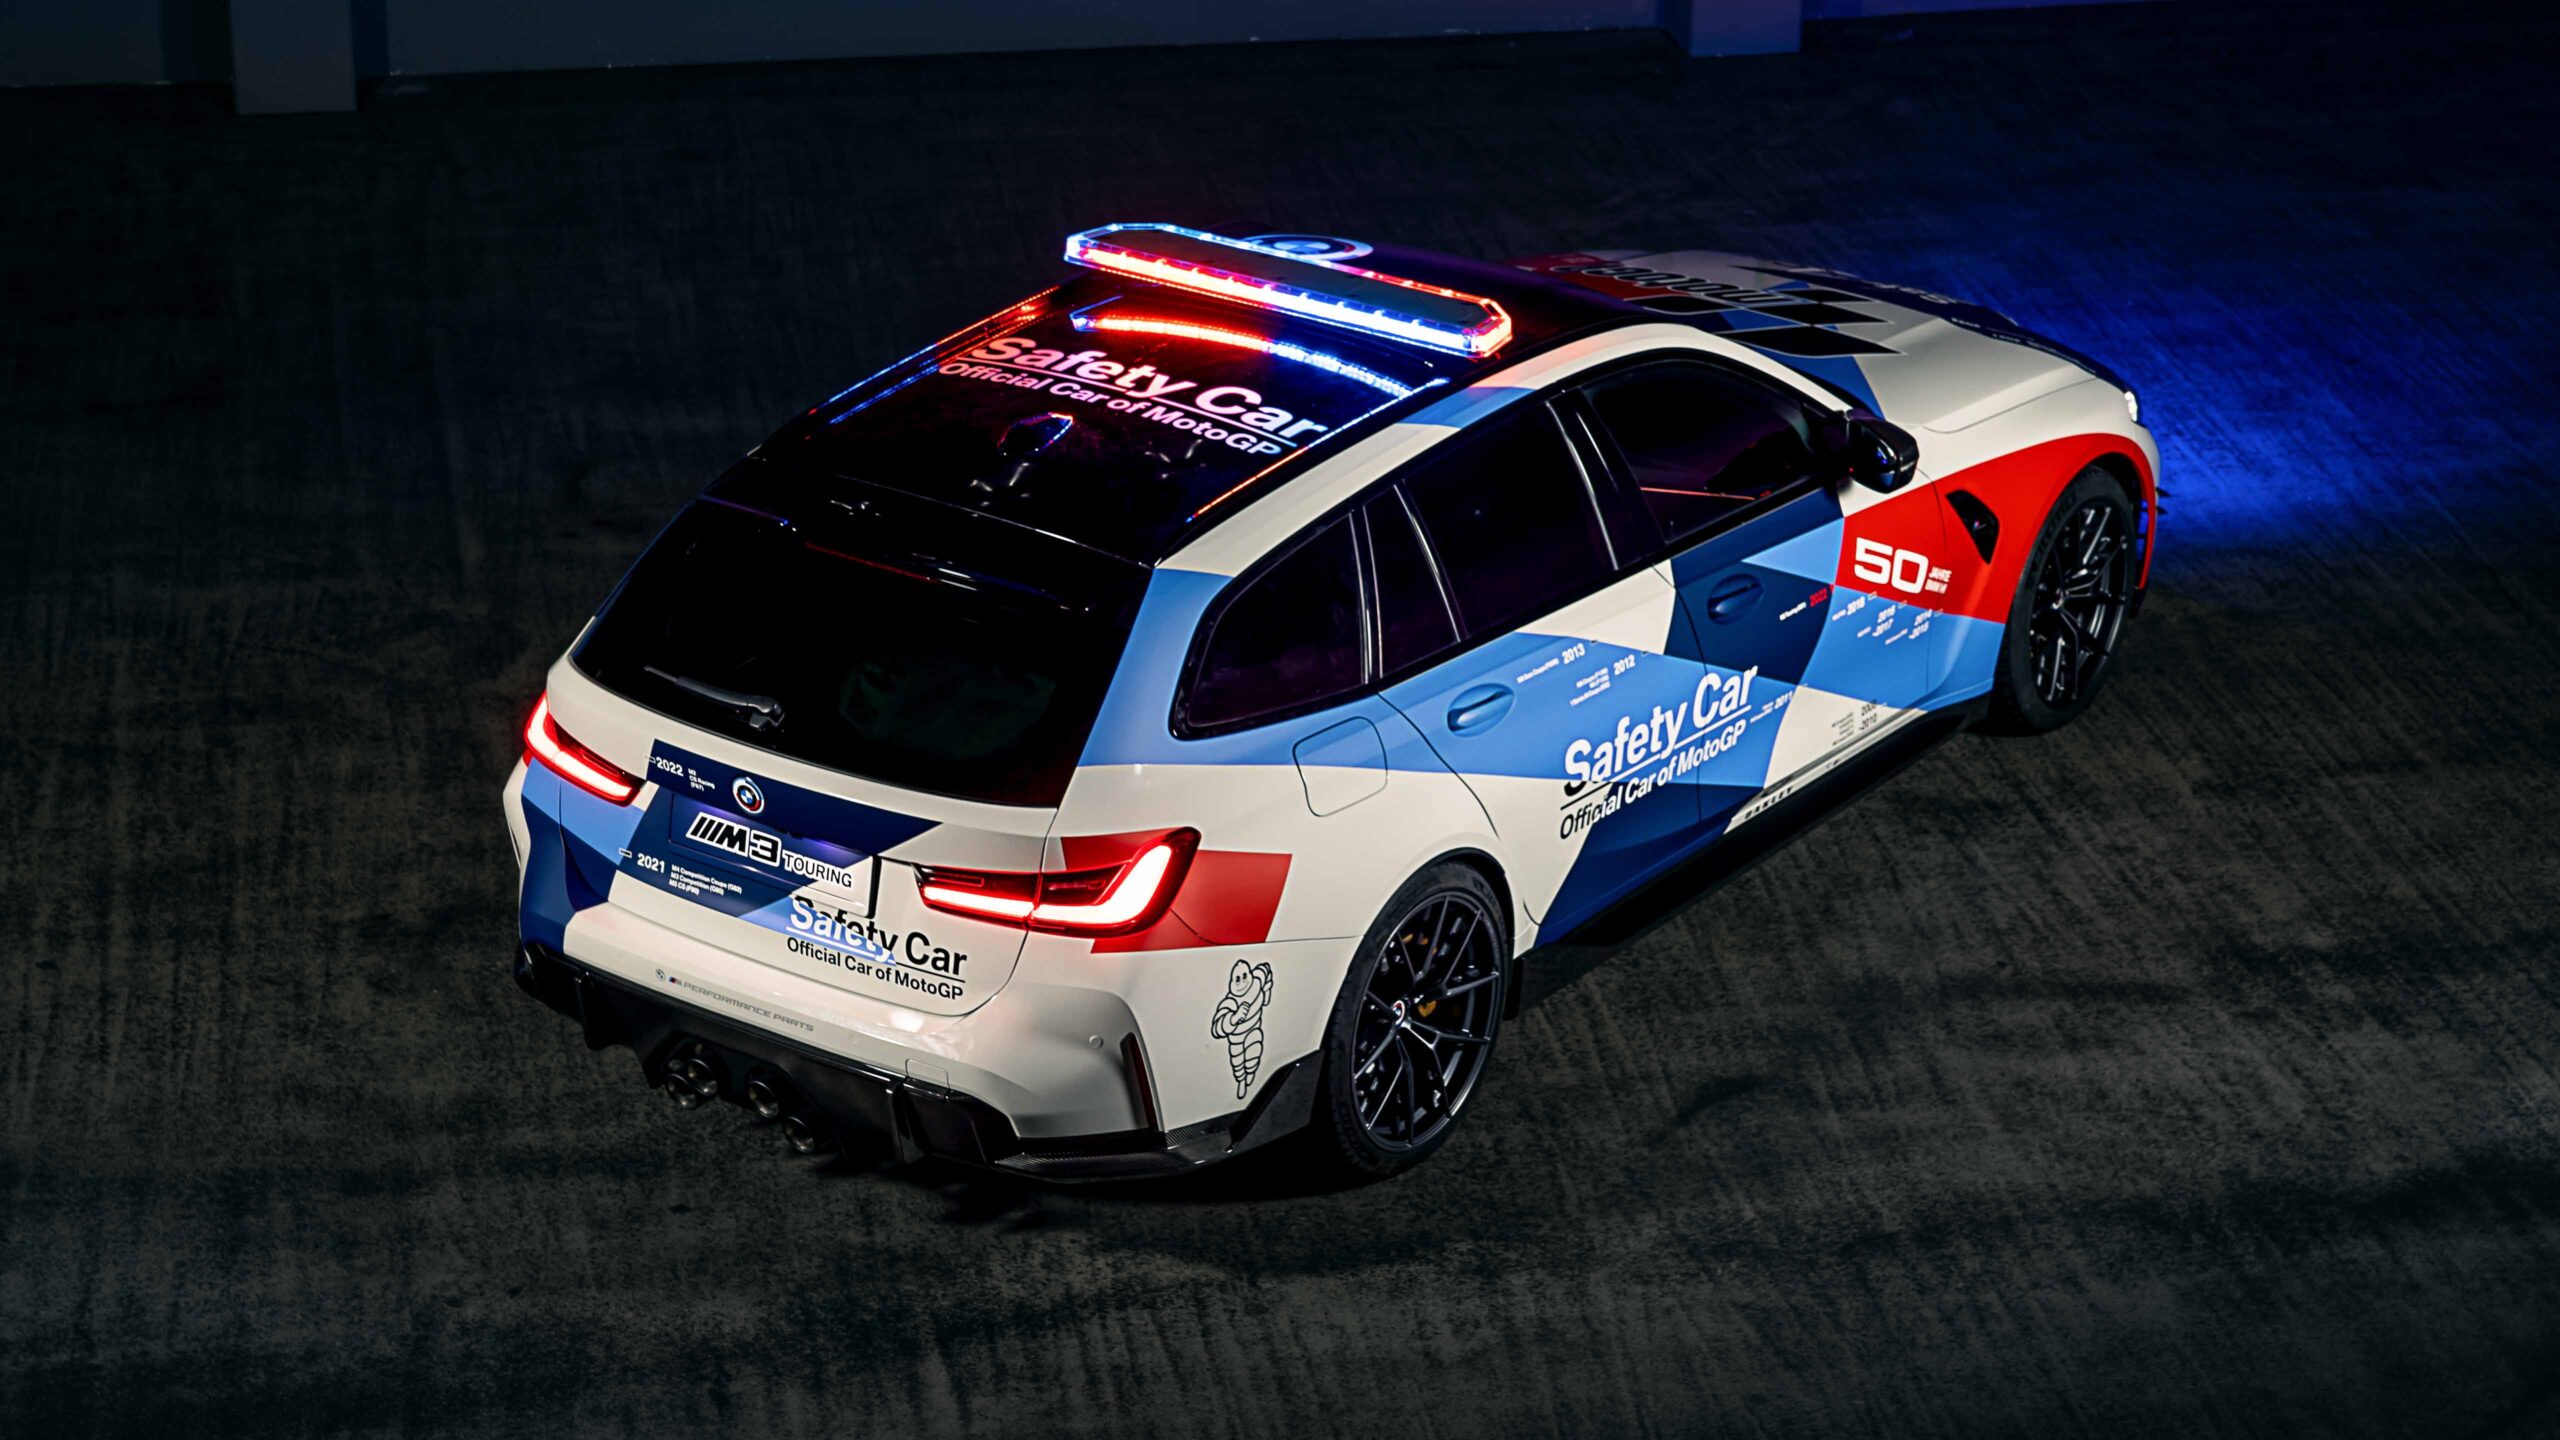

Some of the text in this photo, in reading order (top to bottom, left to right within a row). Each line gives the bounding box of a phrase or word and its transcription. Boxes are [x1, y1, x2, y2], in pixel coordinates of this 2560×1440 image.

[938, 363, 1282, 455] Official Car of MotoGP
[972, 337, 1329, 438] Safety Car
[1854, 537, 1929, 594] 50
[1562, 643, 1585, 664] 2013
[1613, 654, 1636, 676] 2012
[1563, 702, 1688, 797] Safety
[1693, 665, 1758, 728] Car
[655, 756, 684, 777] 2022
[1560, 719, 1747, 840] Official Car of MotoGP
[637, 853, 665, 874] 2021
[679, 875, 710, 890] Competition
[680, 867, 711, 882] Competition
[784, 853, 852, 888] TOURING
[789, 895, 968, 976] Safety Car
[787, 936, 964, 1000] Official Car of MotoGP
[684, 982, 771, 1018] PERFORMANCE
[773, 1013, 815, 1032] PARTS
